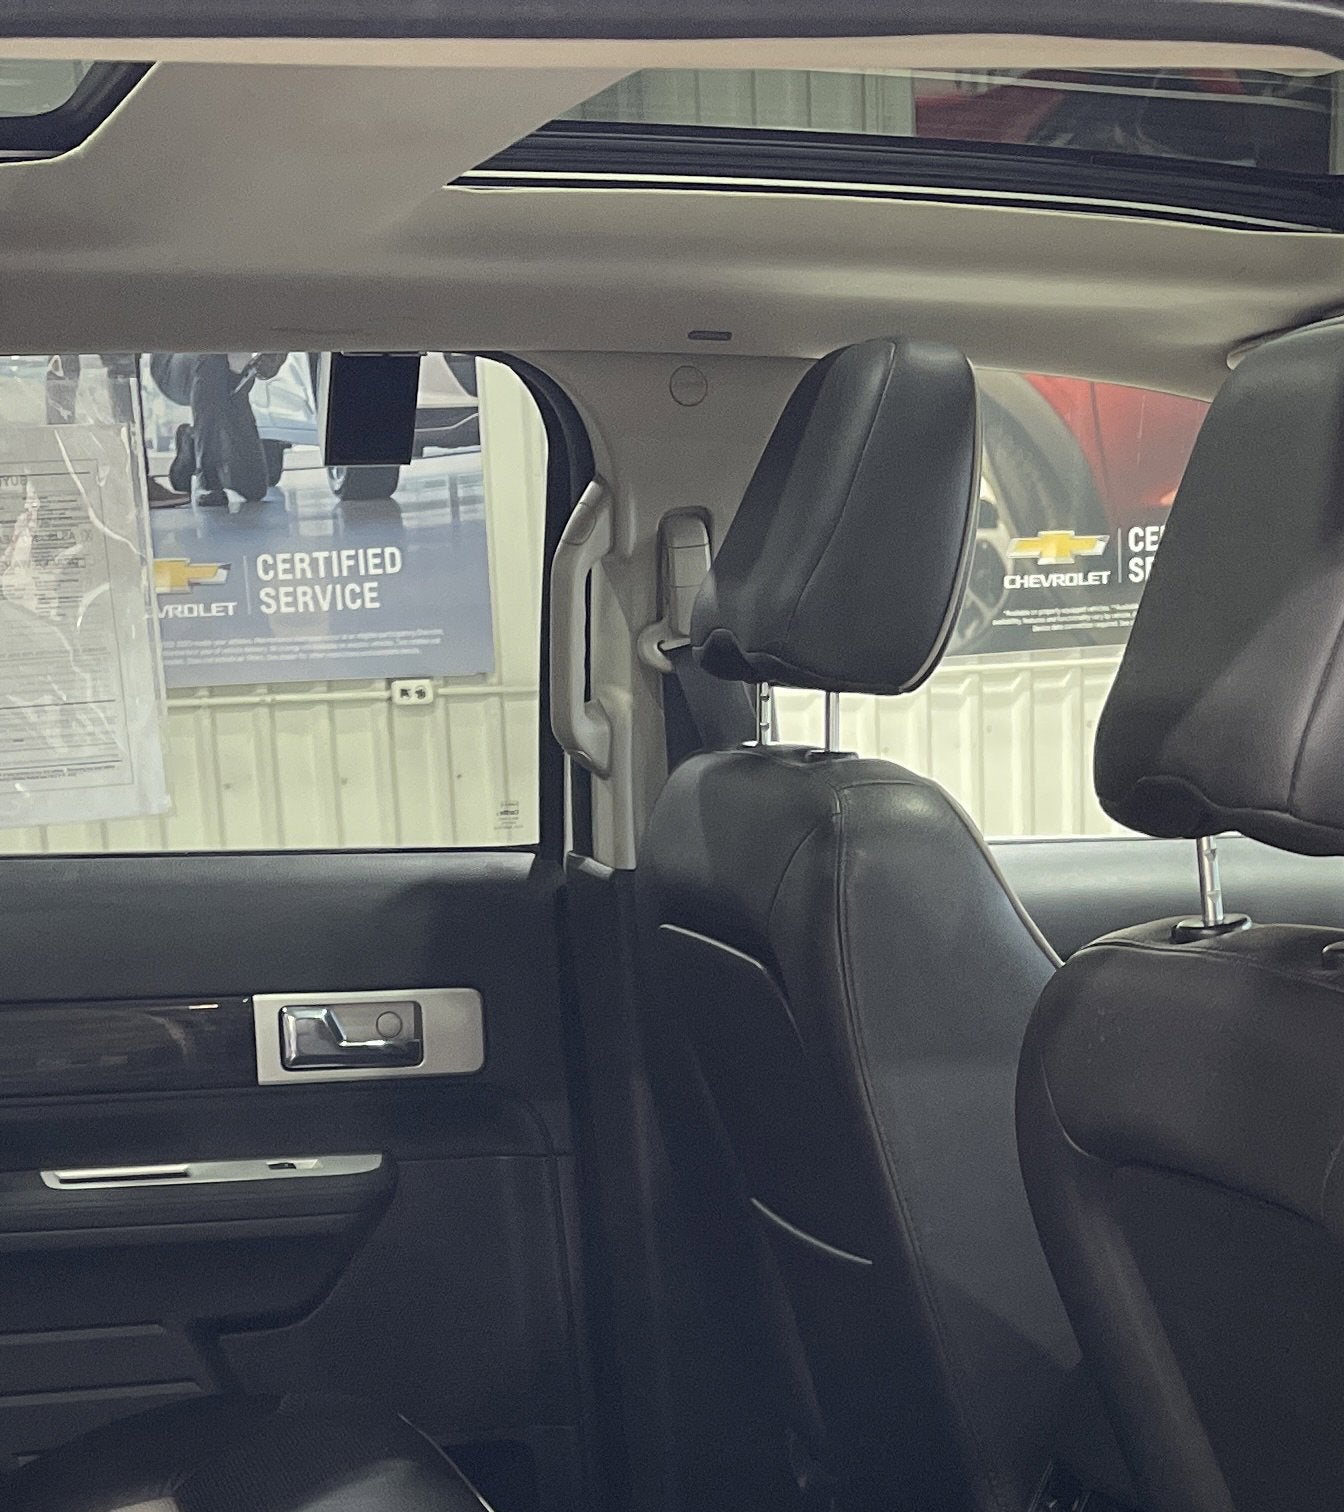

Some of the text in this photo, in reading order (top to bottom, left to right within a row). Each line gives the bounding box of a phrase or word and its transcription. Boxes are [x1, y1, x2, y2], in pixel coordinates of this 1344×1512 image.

[256, 546, 402, 581] CERTIFIED
[1003, 571, 1111, 589] CHEVROLET
[259, 582, 381, 614] SERVICE
